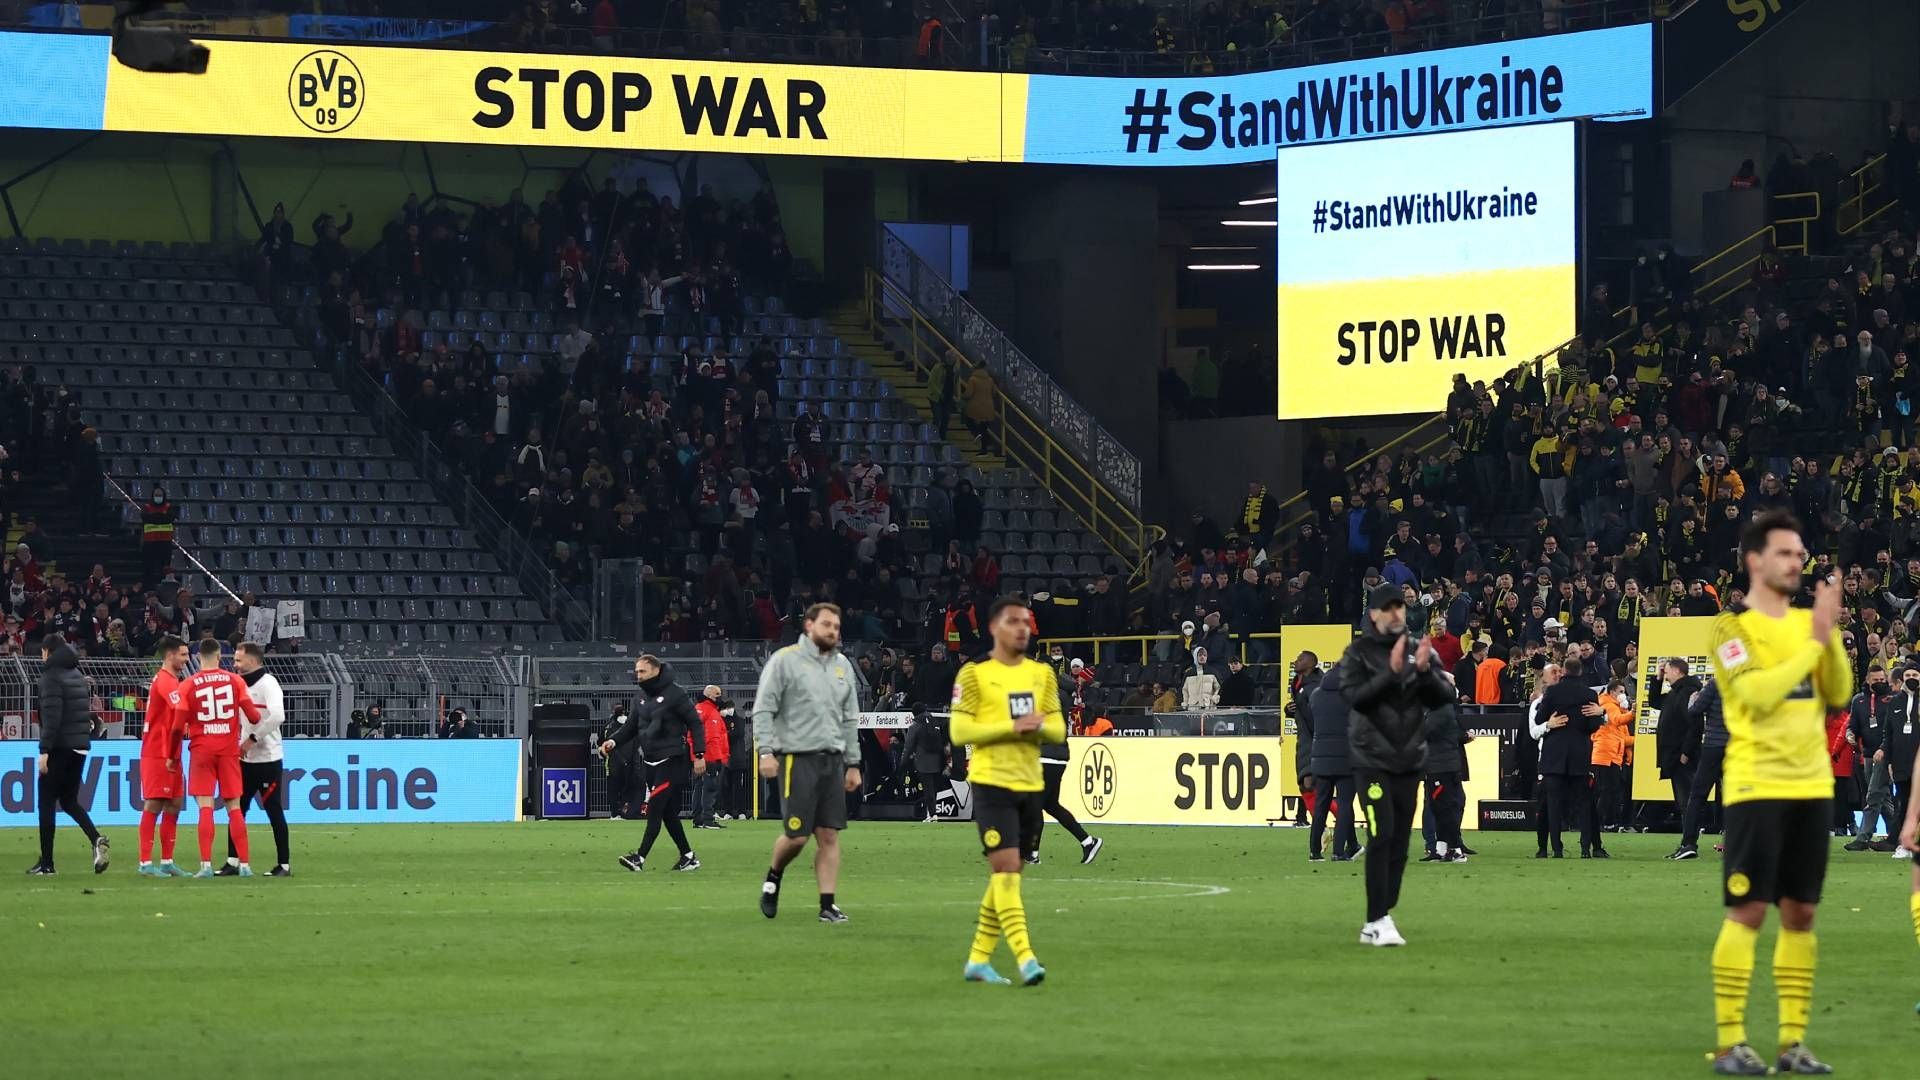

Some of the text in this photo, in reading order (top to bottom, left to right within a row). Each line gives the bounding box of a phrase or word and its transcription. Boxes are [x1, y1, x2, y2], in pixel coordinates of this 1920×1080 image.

[299, 57, 358, 109] BVB
[472, 67, 828, 140] STOP WAR
[316, 109, 337, 125] 09
[1122, 56, 1564, 153] #StandWithUkraine
[1312, 187, 1537, 233] #StandWithUkraine
[1337, 313, 1506, 366] STOP WAR
[195, 684, 234, 722] 32
[859, 715, 870, 726] sky
[876, 715, 899, 726] Fanbank
[547, 779, 581, 804] 1&1
[1084, 750, 1113, 796] BVB
[1174, 753, 1269, 811] STOP
[936, 801, 955, 816] sky
[1092, 796, 1104, 811] 09
[1489, 810, 1526, 820] BUNDESLIGA
